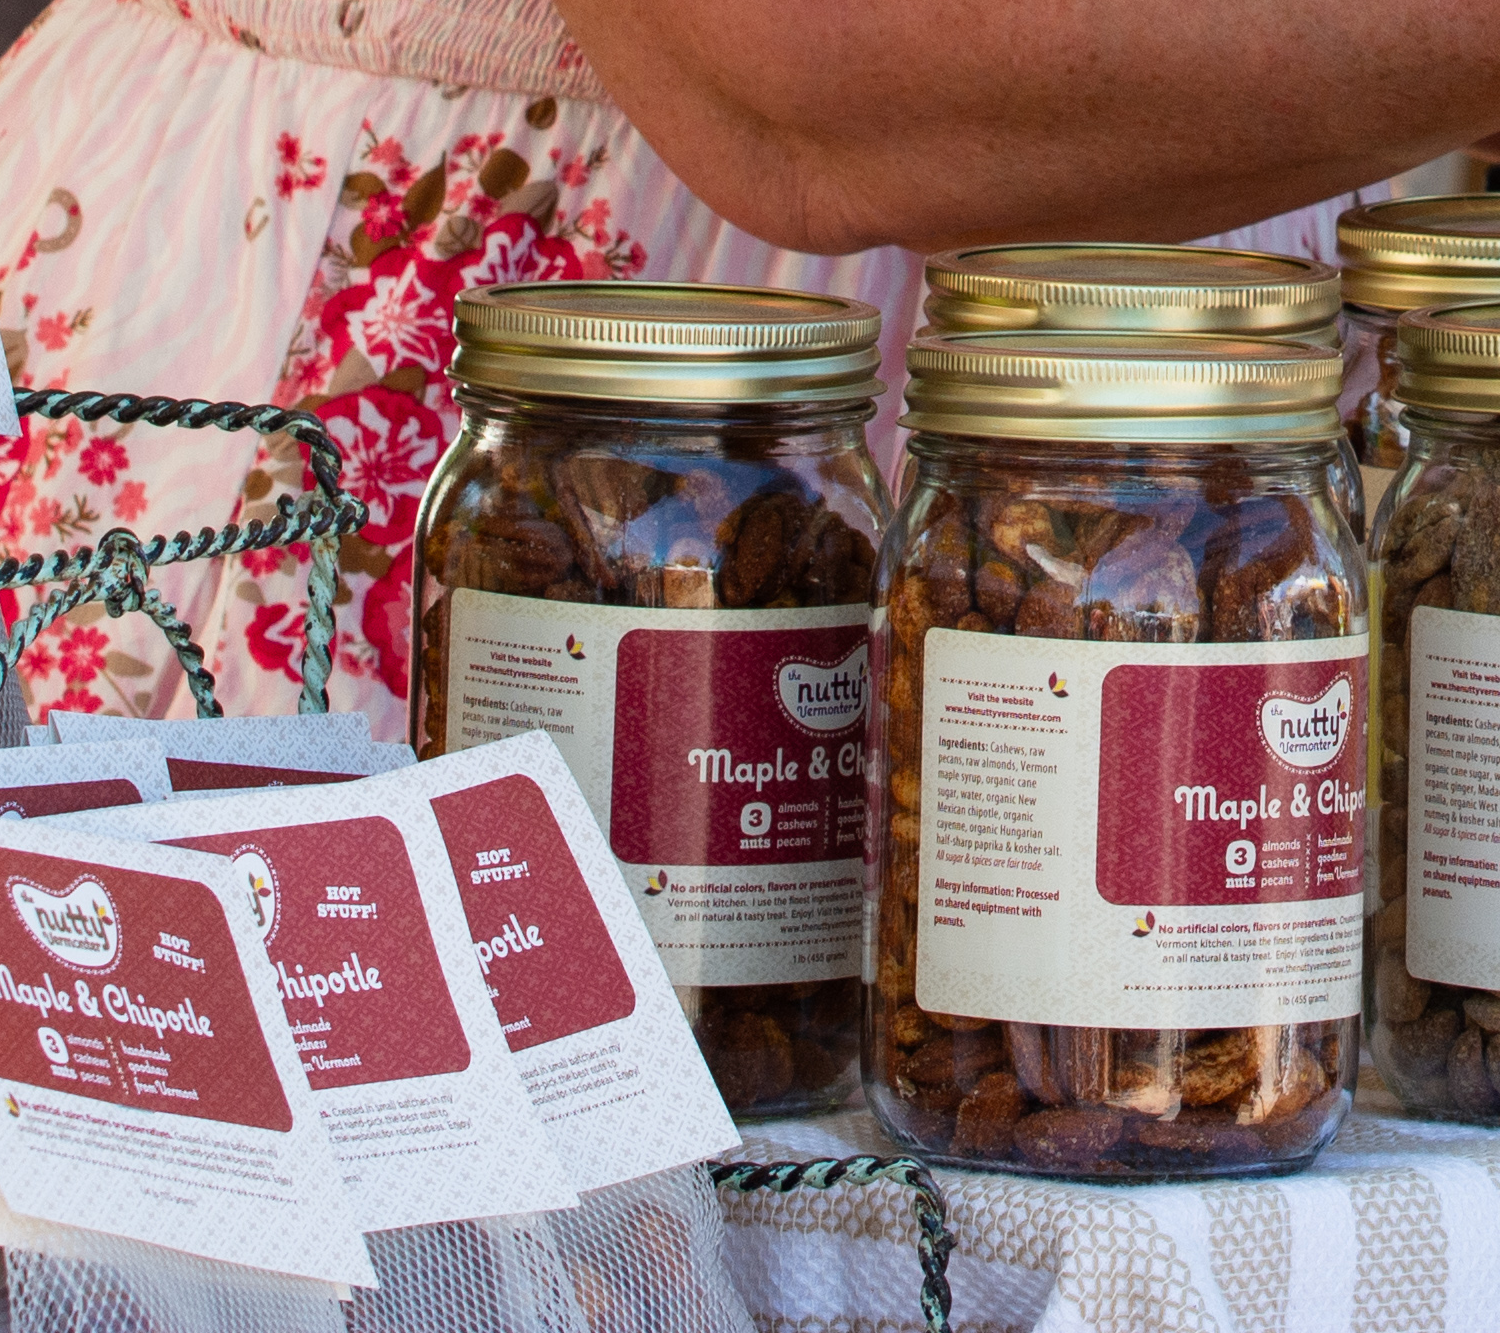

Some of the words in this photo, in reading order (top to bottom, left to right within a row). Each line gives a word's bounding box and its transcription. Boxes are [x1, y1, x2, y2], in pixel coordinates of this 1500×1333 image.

[1280, 709, 1340, 747] nutty
[1279, 739, 1332, 754] Vermonter
[688, 748, 798, 791] Maple
[808, 747, 830, 780] &
[1174, 785, 1281, 830] Maple
[1290, 783, 1311, 818] &
[1261, 839, 1301, 852] almonds
[475, 848, 511, 866] HOT
[1261, 856, 1299, 869] cashews
[470, 861, 531, 885] STUFF!
[1225, 874, 1256, 889] nuts
[1261, 874, 1294, 888] pecans
[326, 886, 361, 901] HOT
[317, 902, 378, 920] STUFF!
[159, 932, 190, 954] HOT
[153, 944, 206, 974] STUFF!
[75, 980, 102, 1018] &
[103, 984, 214, 1039] Chipotle
